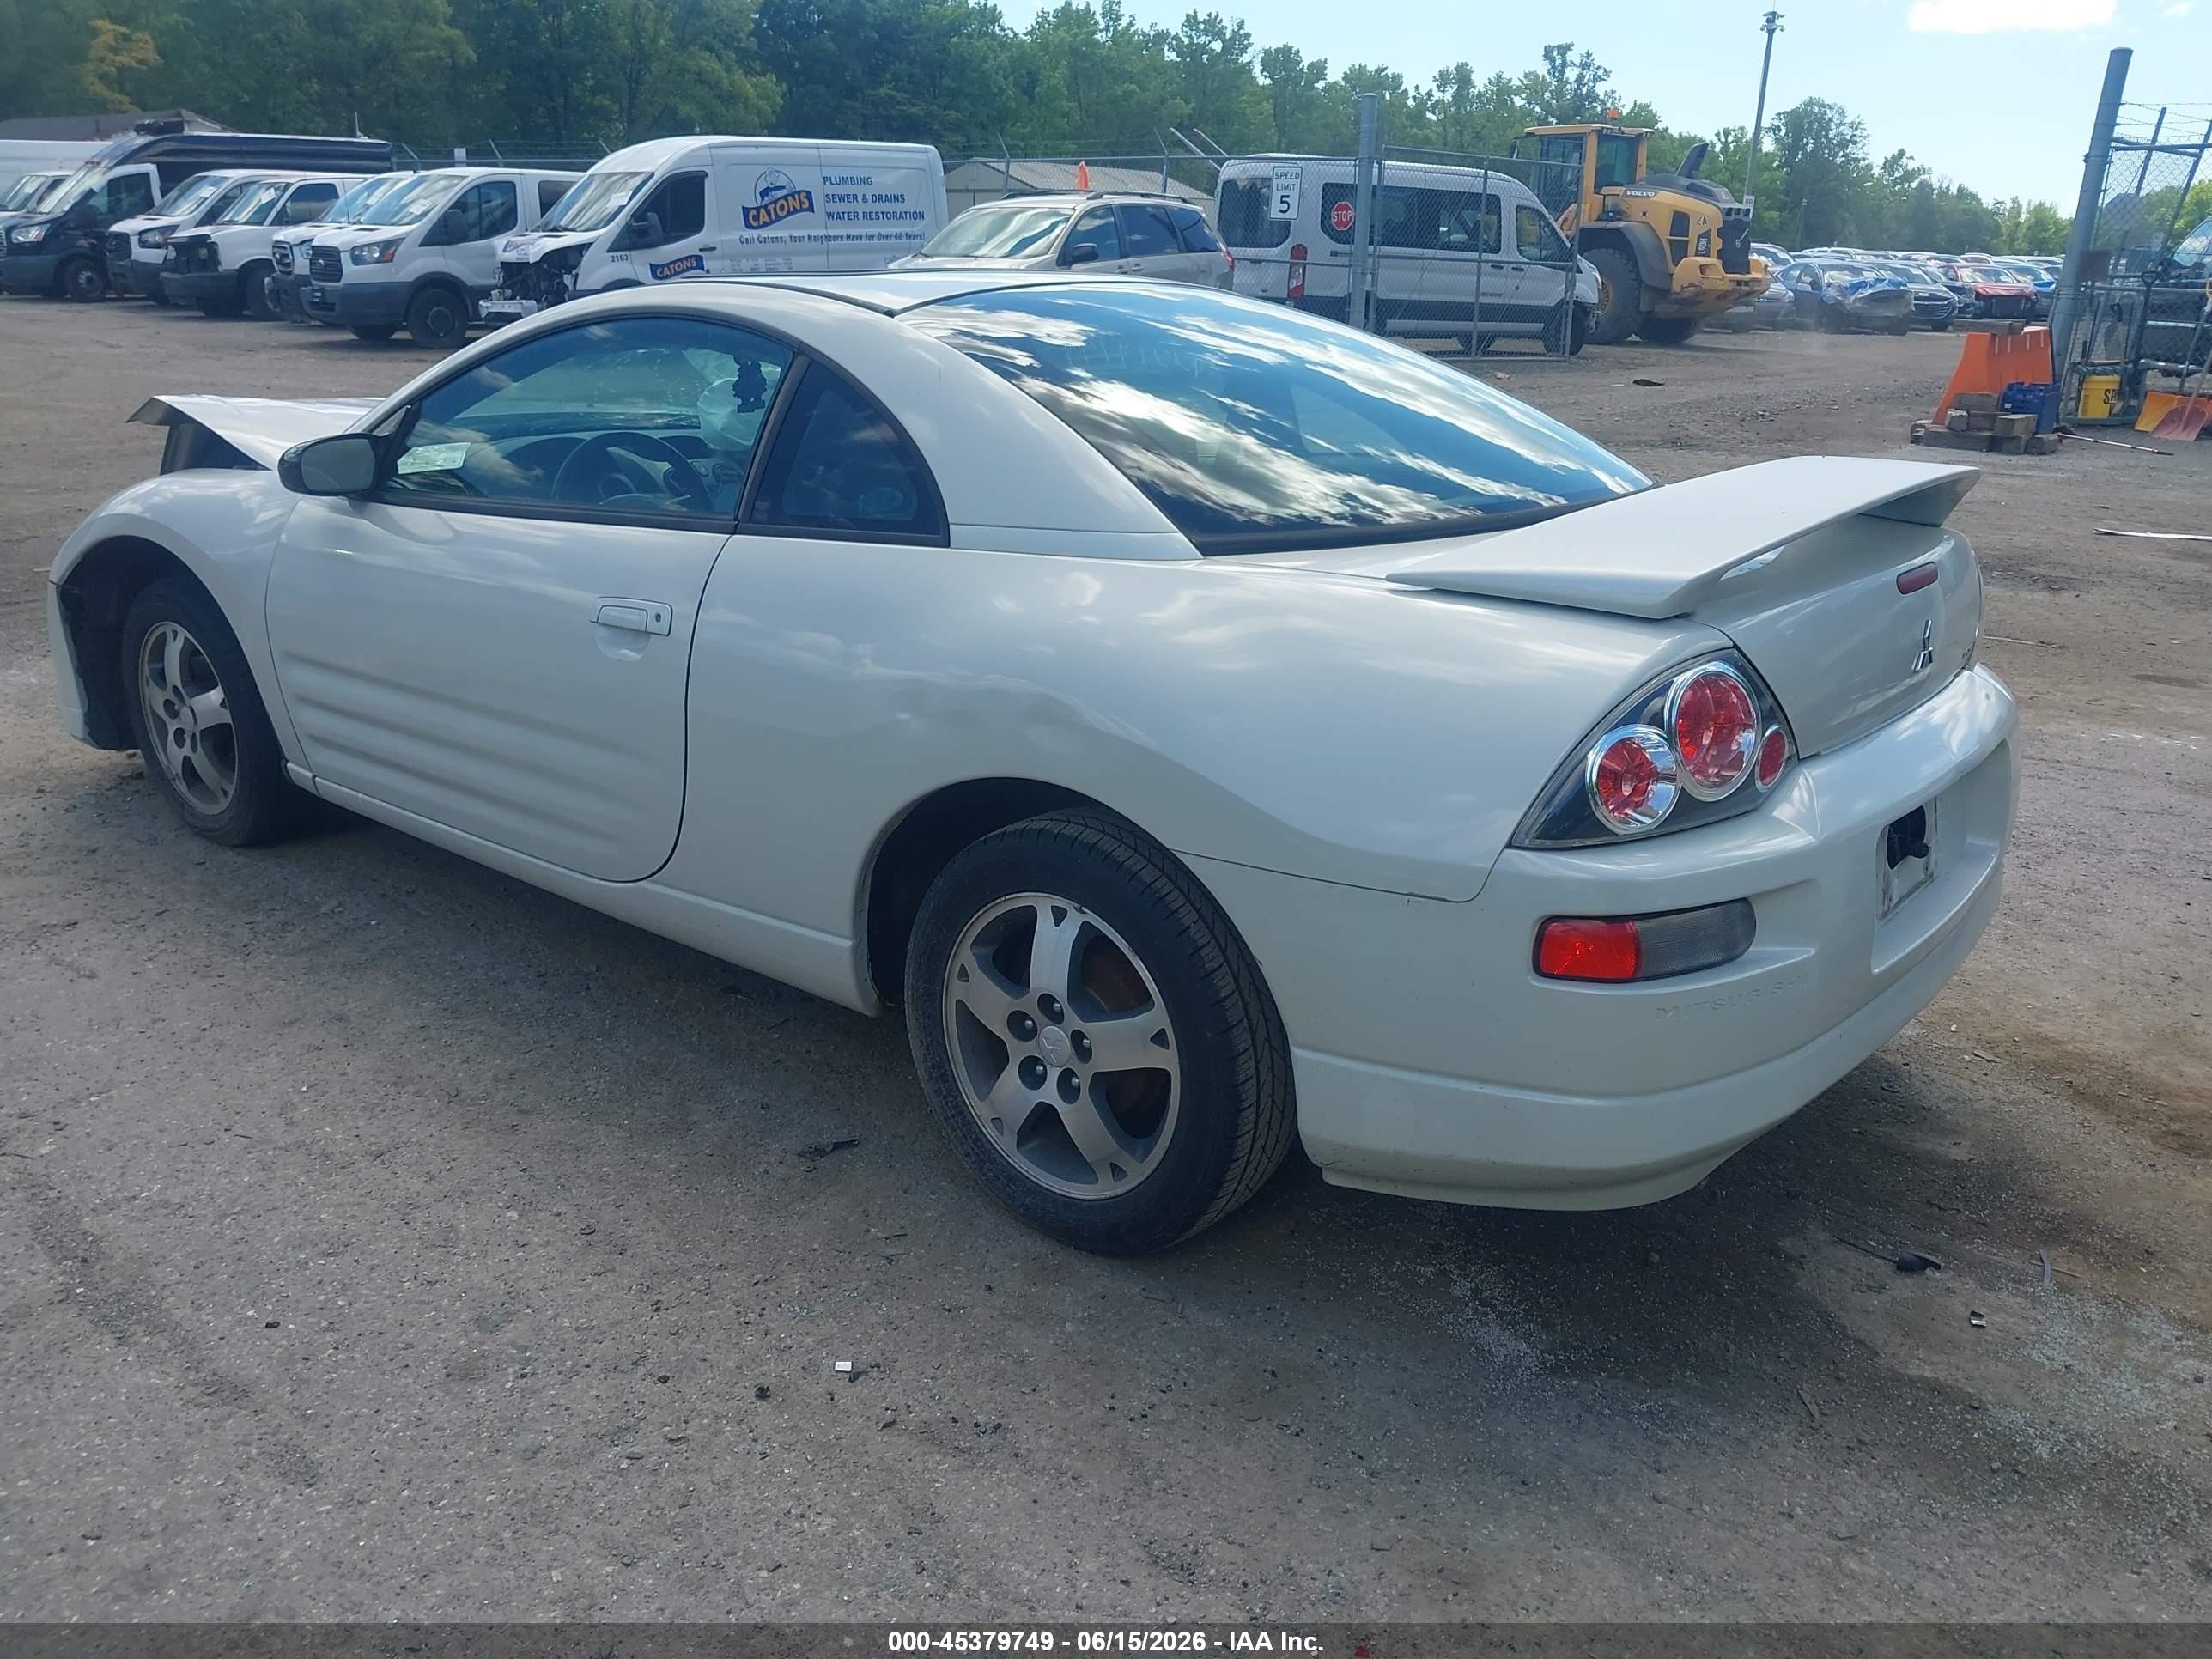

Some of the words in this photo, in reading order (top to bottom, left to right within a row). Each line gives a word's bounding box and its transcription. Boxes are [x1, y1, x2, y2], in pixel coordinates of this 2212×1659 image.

[823, 176, 873, 186] PLUMBING
[1275, 172, 1300, 180] SPEED
[1276, 183, 1296, 191] LIMIT
[825, 193, 859, 204] SEWER
[861, 193, 868, 204] &
[871, 193, 906, 204] DRAINS
[1279, 194, 1291, 214] 5
[748, 191, 809, 227] CATONS
[825, 210, 860, 221] WATER
[862, 210, 925, 221] RESTORATION
[1333, 210, 1352, 222] STOP
[738, 234, 755, 245] Call
[757, 234, 787, 245] Catons,
[789, 234, 805, 243] Your
[807, 233, 844, 245] Neighbors
[846, 233, 863, 241] Have
[865, 232, 876, 241] for
[877, 232, 892, 241] Over
[656, 258, 697, 277] CATONS
